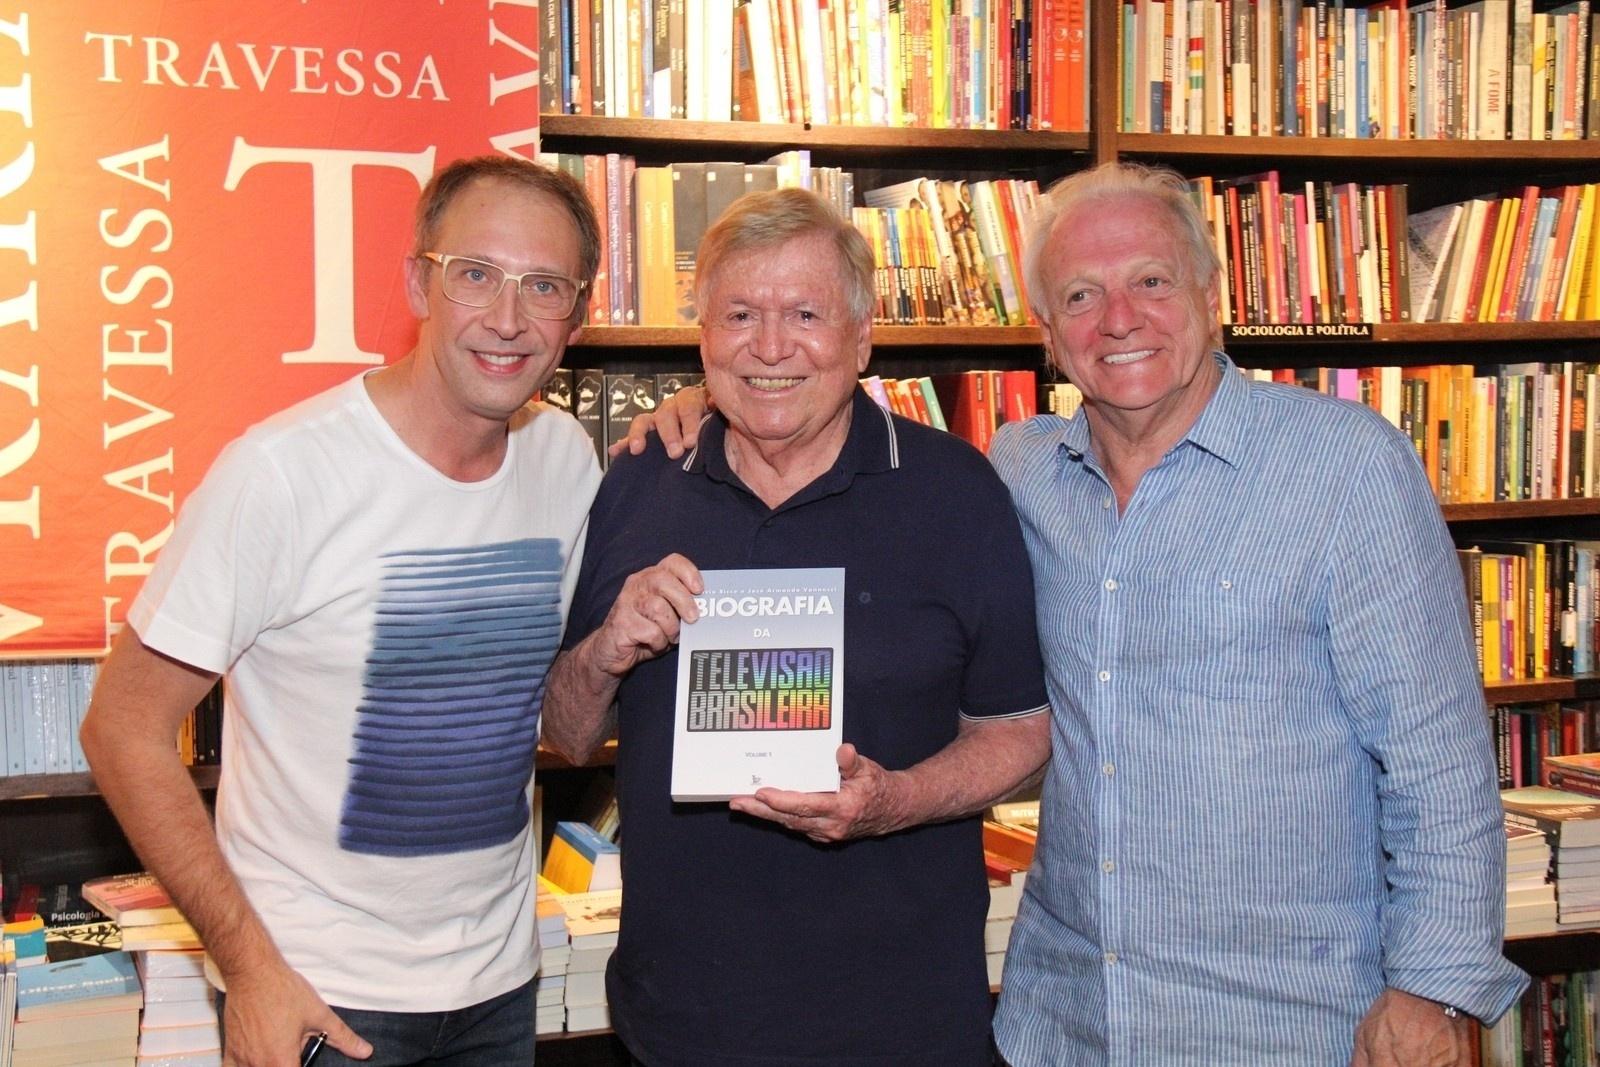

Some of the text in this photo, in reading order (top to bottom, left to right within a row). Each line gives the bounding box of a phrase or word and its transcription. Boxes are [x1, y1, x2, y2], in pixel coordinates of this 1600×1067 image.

[84, 32, 450, 102] TRAVESSA
[1487, 68, 1500, 115] A FOME
[223, 136, 437, 364] T
[1231, 323, 1369, 336] SOCIOLOGIA E POLÍTICA
[693, 595, 835, 618] BIOGRAFIA
[753, 628, 771, 639] DA
[689, 689, 830, 729] BRASILEIRA
[51, 909, 101, 923] Psicologia
